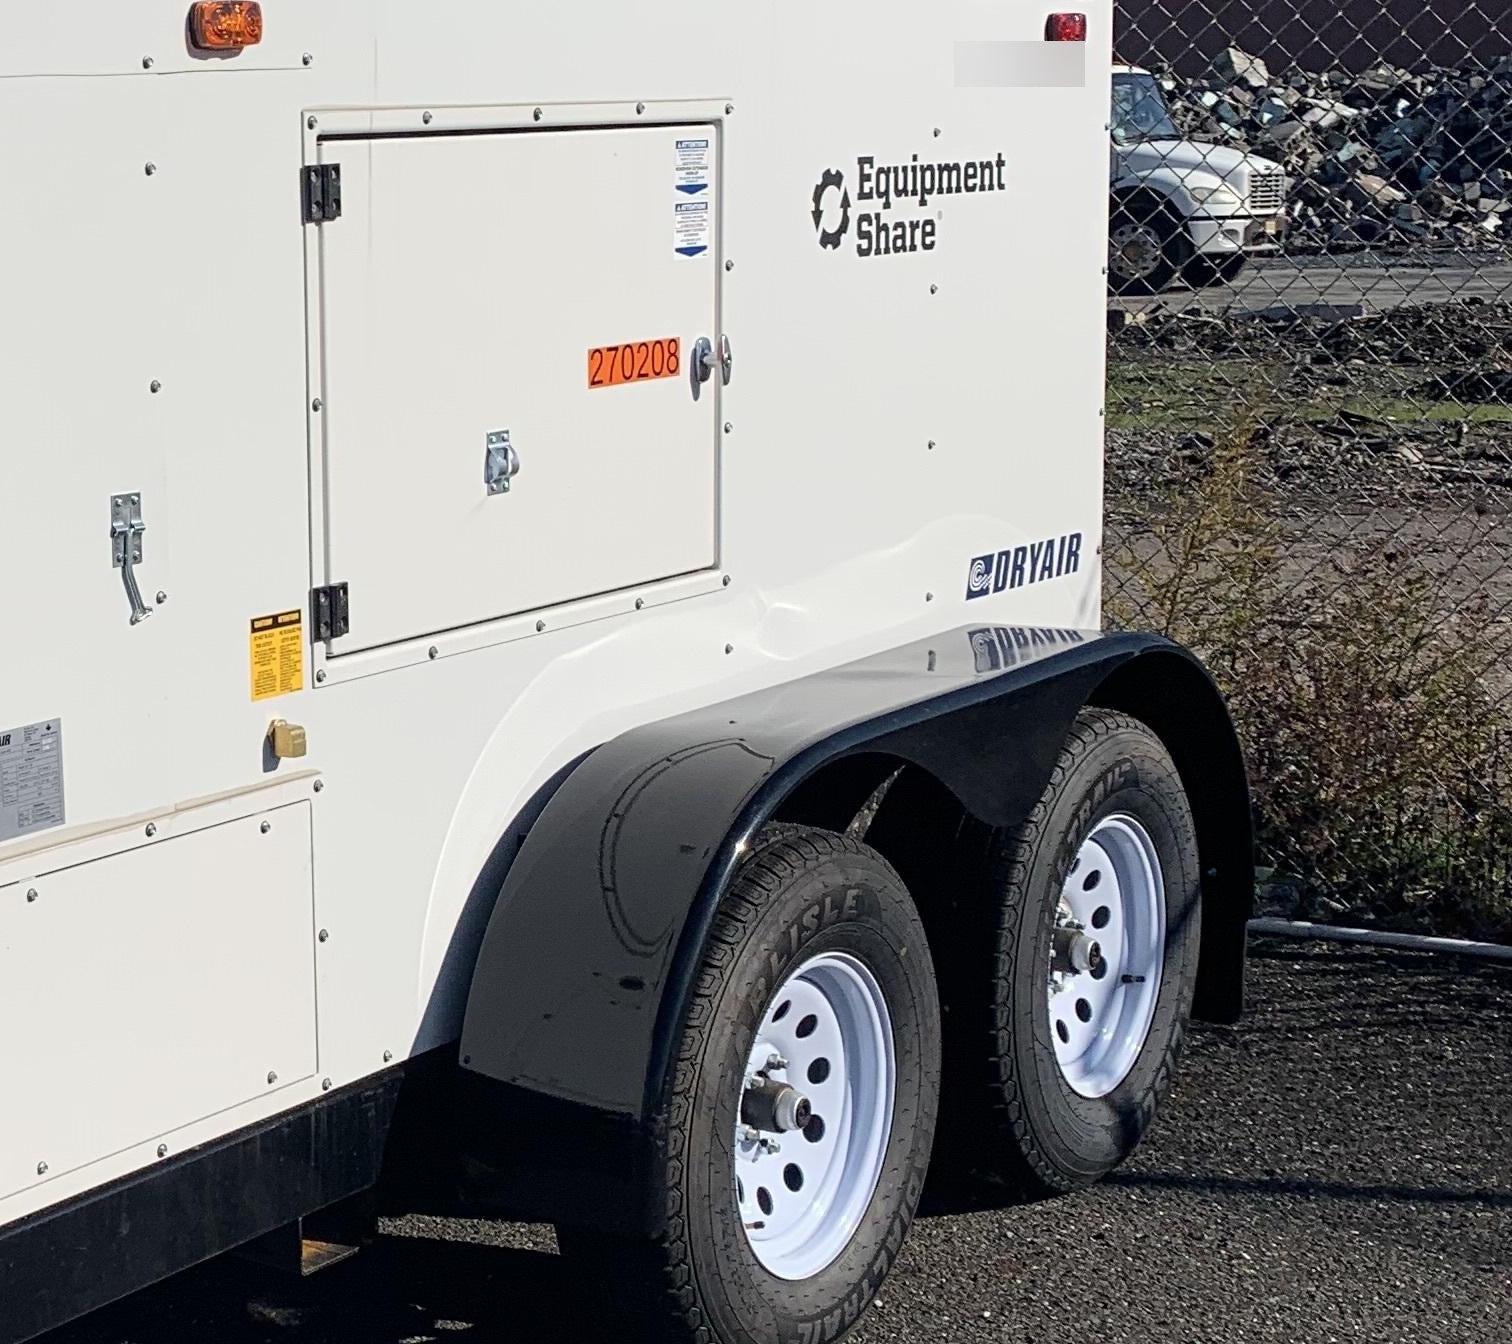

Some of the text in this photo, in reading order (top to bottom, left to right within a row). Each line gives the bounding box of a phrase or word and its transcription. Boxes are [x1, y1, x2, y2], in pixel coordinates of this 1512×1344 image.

[856, 152, 1006, 210] Equipment
[856, 212, 936, 258] Share
[589, 338, 680, 386] 270208
[992, 532, 1082, 594] DRYAIR
